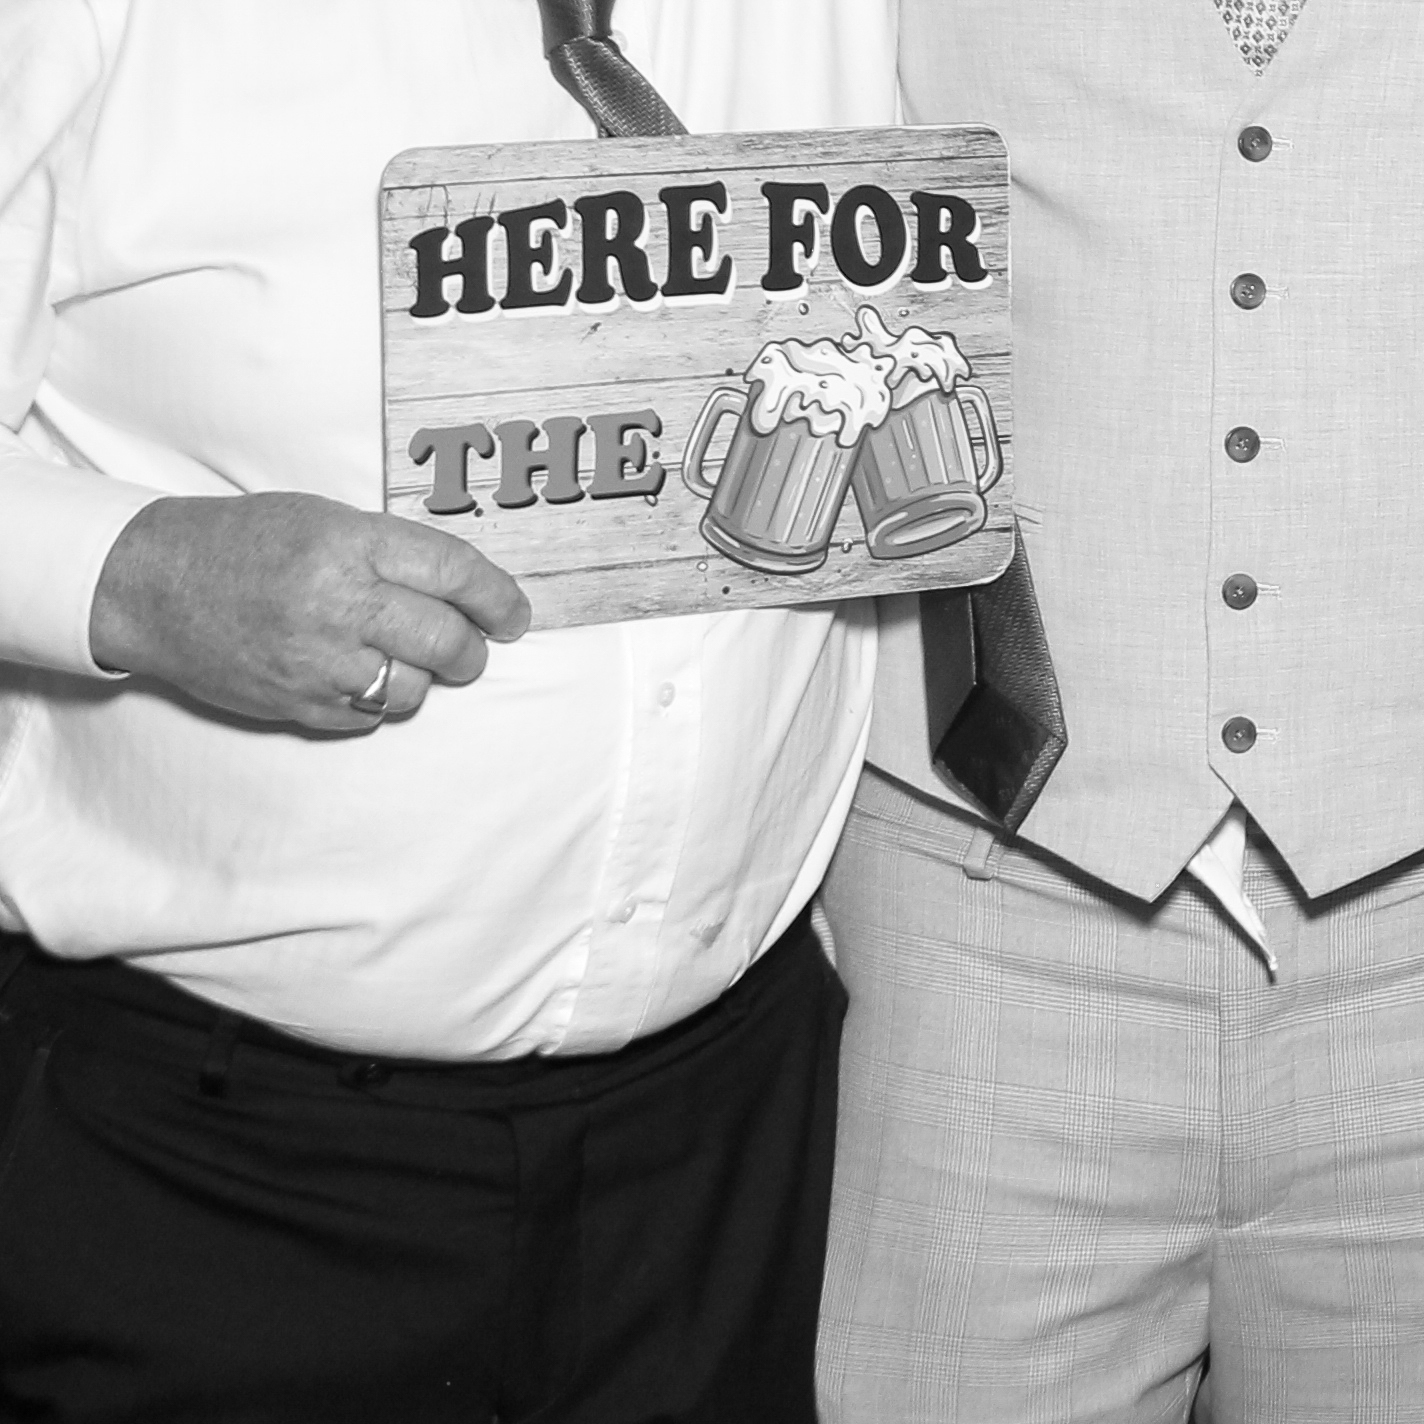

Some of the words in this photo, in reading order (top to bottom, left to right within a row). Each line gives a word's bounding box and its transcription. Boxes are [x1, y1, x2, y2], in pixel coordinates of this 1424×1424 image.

[407, 180, 733, 318] HERE
[760, 181, 990, 292] FOR
[407, 409, 667, 516] THE
